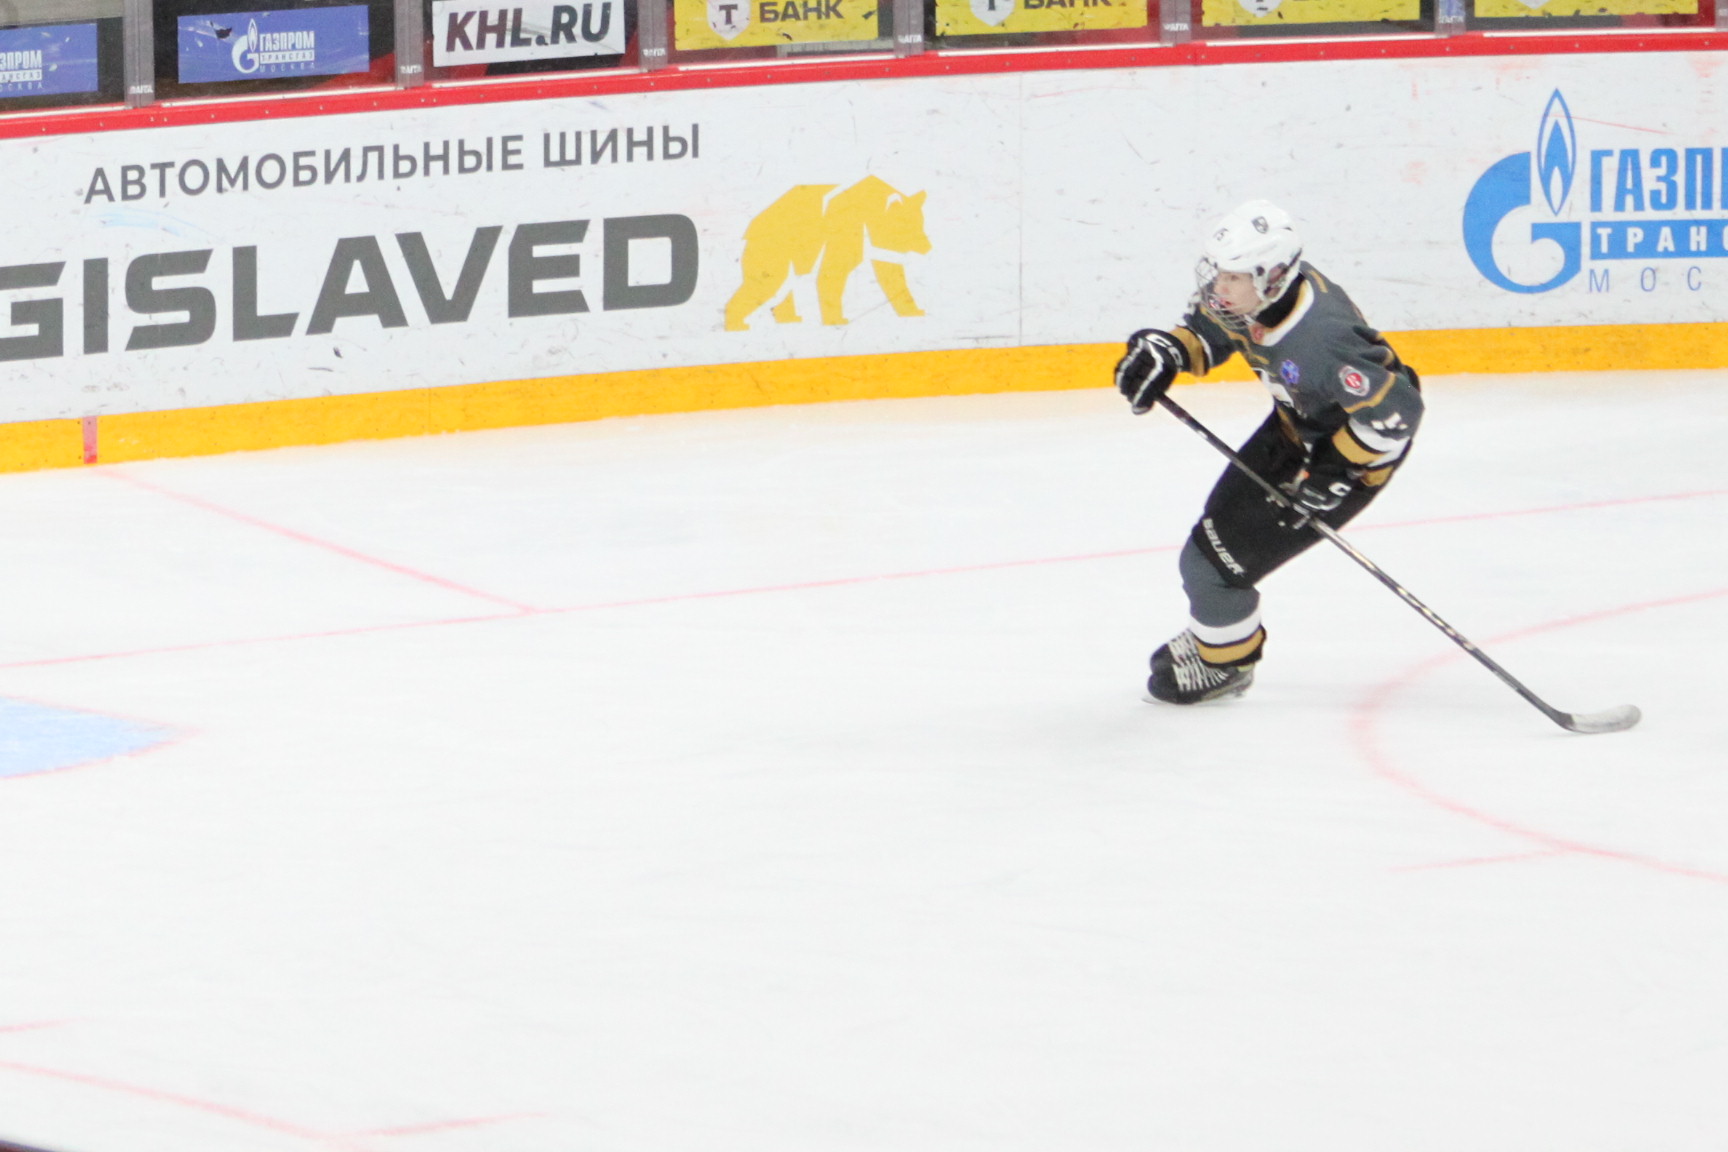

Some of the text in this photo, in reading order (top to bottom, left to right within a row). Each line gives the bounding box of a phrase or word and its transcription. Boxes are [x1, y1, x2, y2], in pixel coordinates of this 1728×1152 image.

[260, 30, 315, 51] ГАЗПРОМ
[445, 2, 612, 52] KHL.RU
[83, 124, 700, 205] АВТОМОБИЛЬНЫЕ ШИНЫ
[1590, 147, 1728, 213] ГАЗП
[1596, 224, 1728, 254] ТРАН
[1589, 266, 1702, 293] МОС
